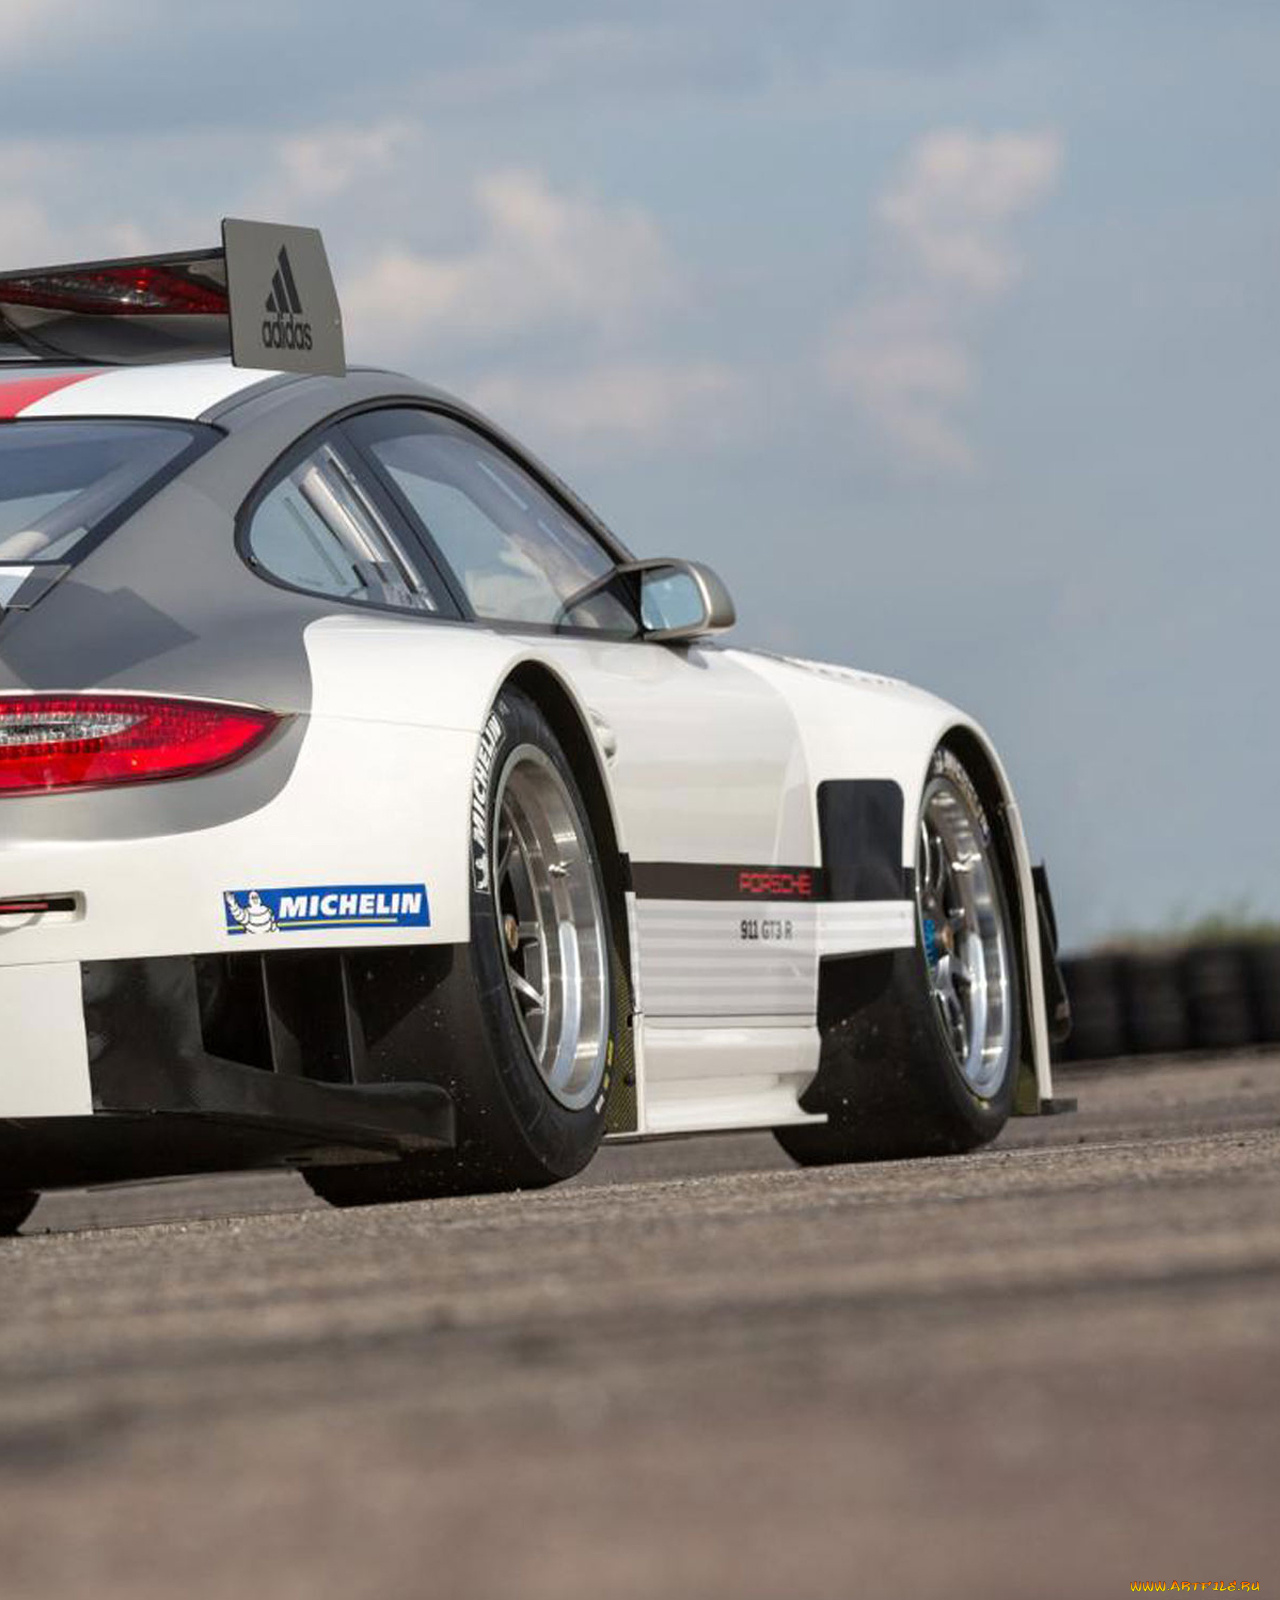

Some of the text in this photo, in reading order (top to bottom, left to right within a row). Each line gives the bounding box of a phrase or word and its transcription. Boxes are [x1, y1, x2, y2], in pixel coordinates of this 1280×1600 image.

[262, 312, 313, 351] adidas
[472, 712, 502, 850] MICHELIN
[739, 873, 812, 894] PORSCHE
[279, 892, 422, 918] MICHELIN
[741, 919, 794, 940] 911 GT3 R
